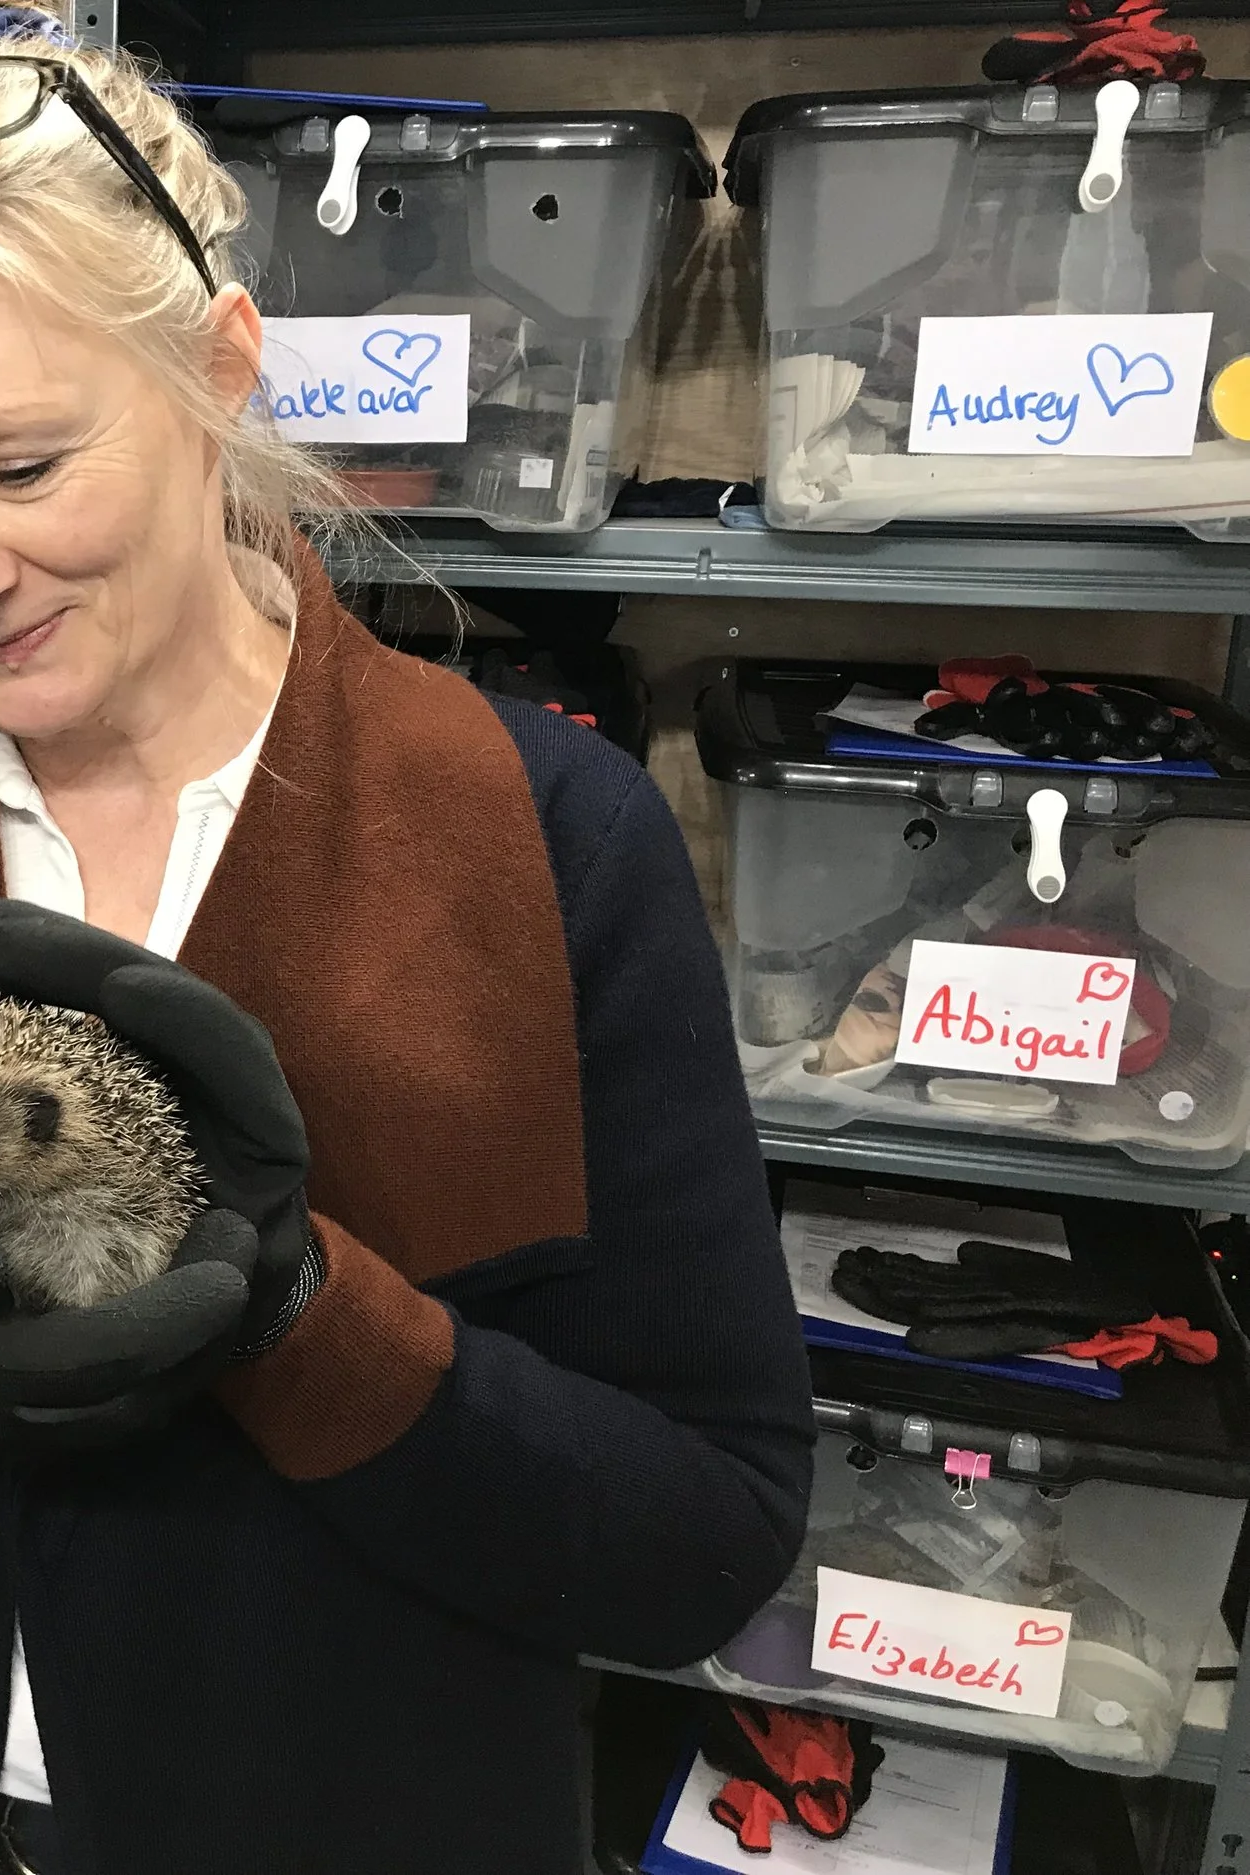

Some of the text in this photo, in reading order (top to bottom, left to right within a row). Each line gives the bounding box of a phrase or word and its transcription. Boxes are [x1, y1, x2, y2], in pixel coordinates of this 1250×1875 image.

[926, 383, 1081, 446] Audrey
[911, 983, 1112, 1073] Abigail
[827, 1612, 1023, 1696] Elizabeth
